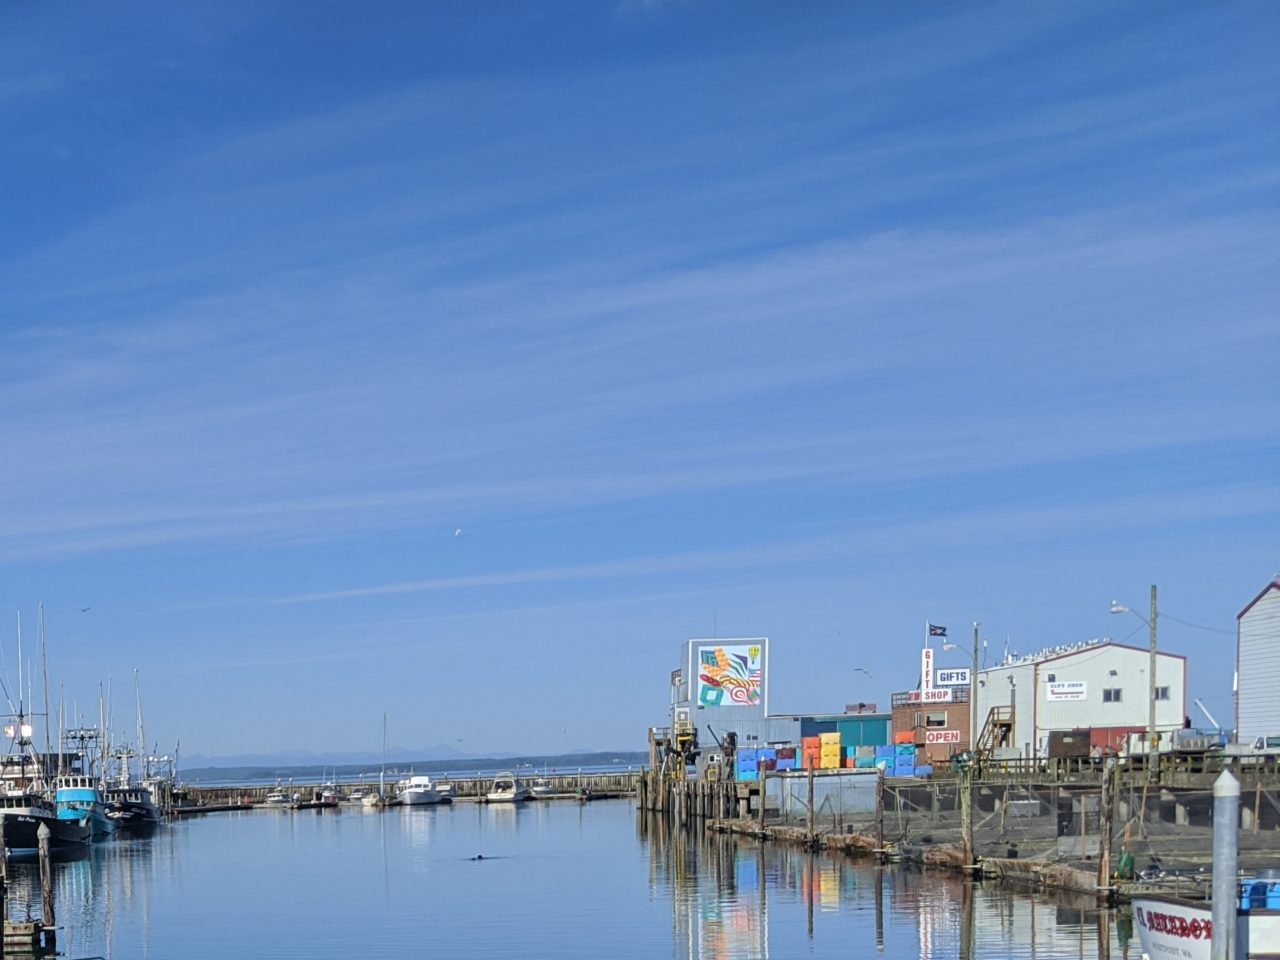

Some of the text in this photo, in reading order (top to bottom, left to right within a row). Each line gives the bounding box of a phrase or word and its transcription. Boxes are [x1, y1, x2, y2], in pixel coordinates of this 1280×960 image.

[939, 671, 967, 682] GIFTS
[924, 690, 949, 700] SHOP
[926, 732, 959, 742] OPEN
